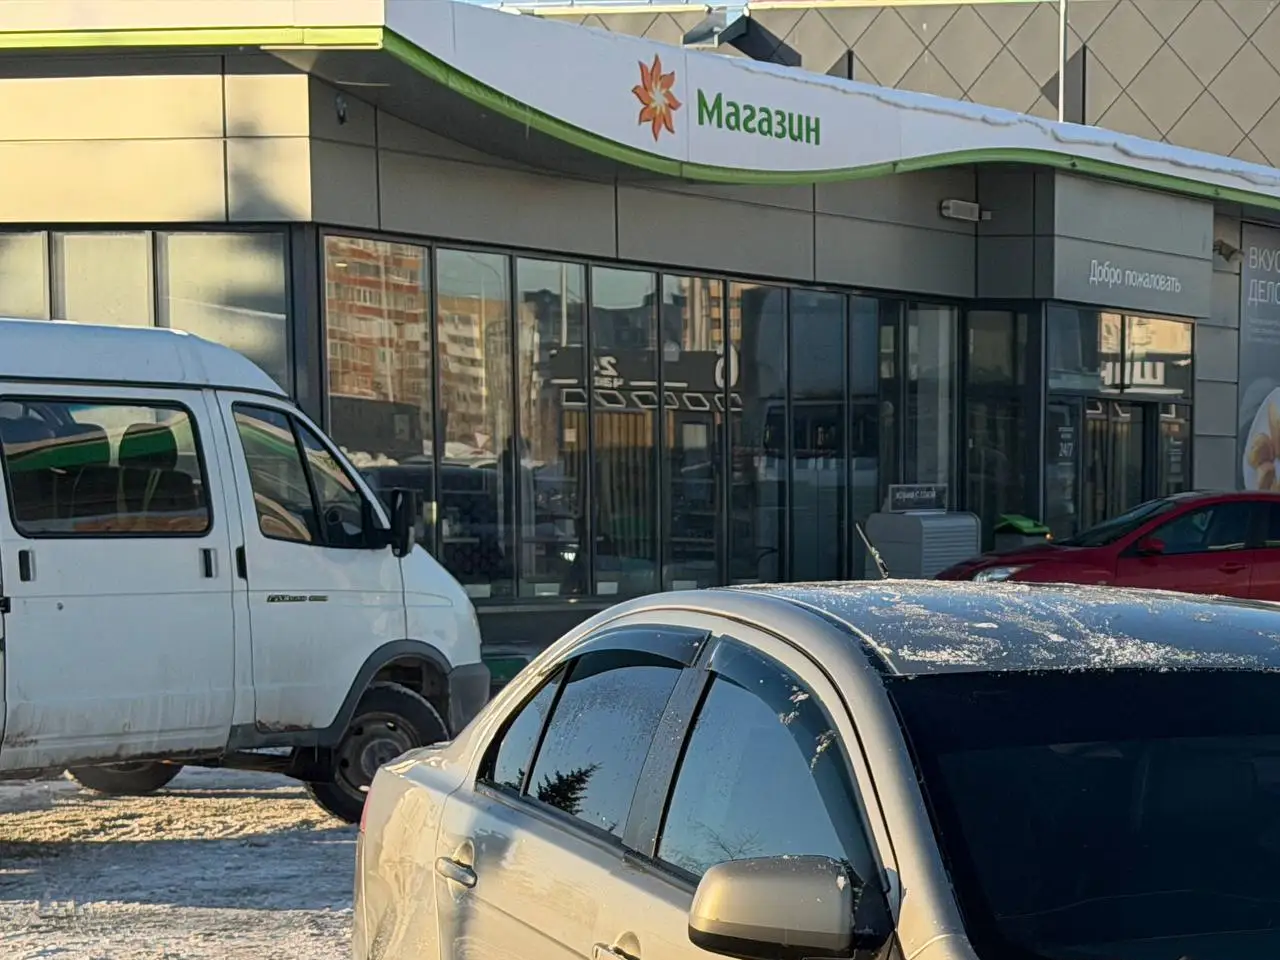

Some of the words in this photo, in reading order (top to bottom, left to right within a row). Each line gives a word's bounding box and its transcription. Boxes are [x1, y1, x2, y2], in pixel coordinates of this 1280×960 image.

[697, 88, 820, 146] Магазин
[1090, 260, 1121, 288] Добро
[1125, 270, 1182, 293] пожаловать
